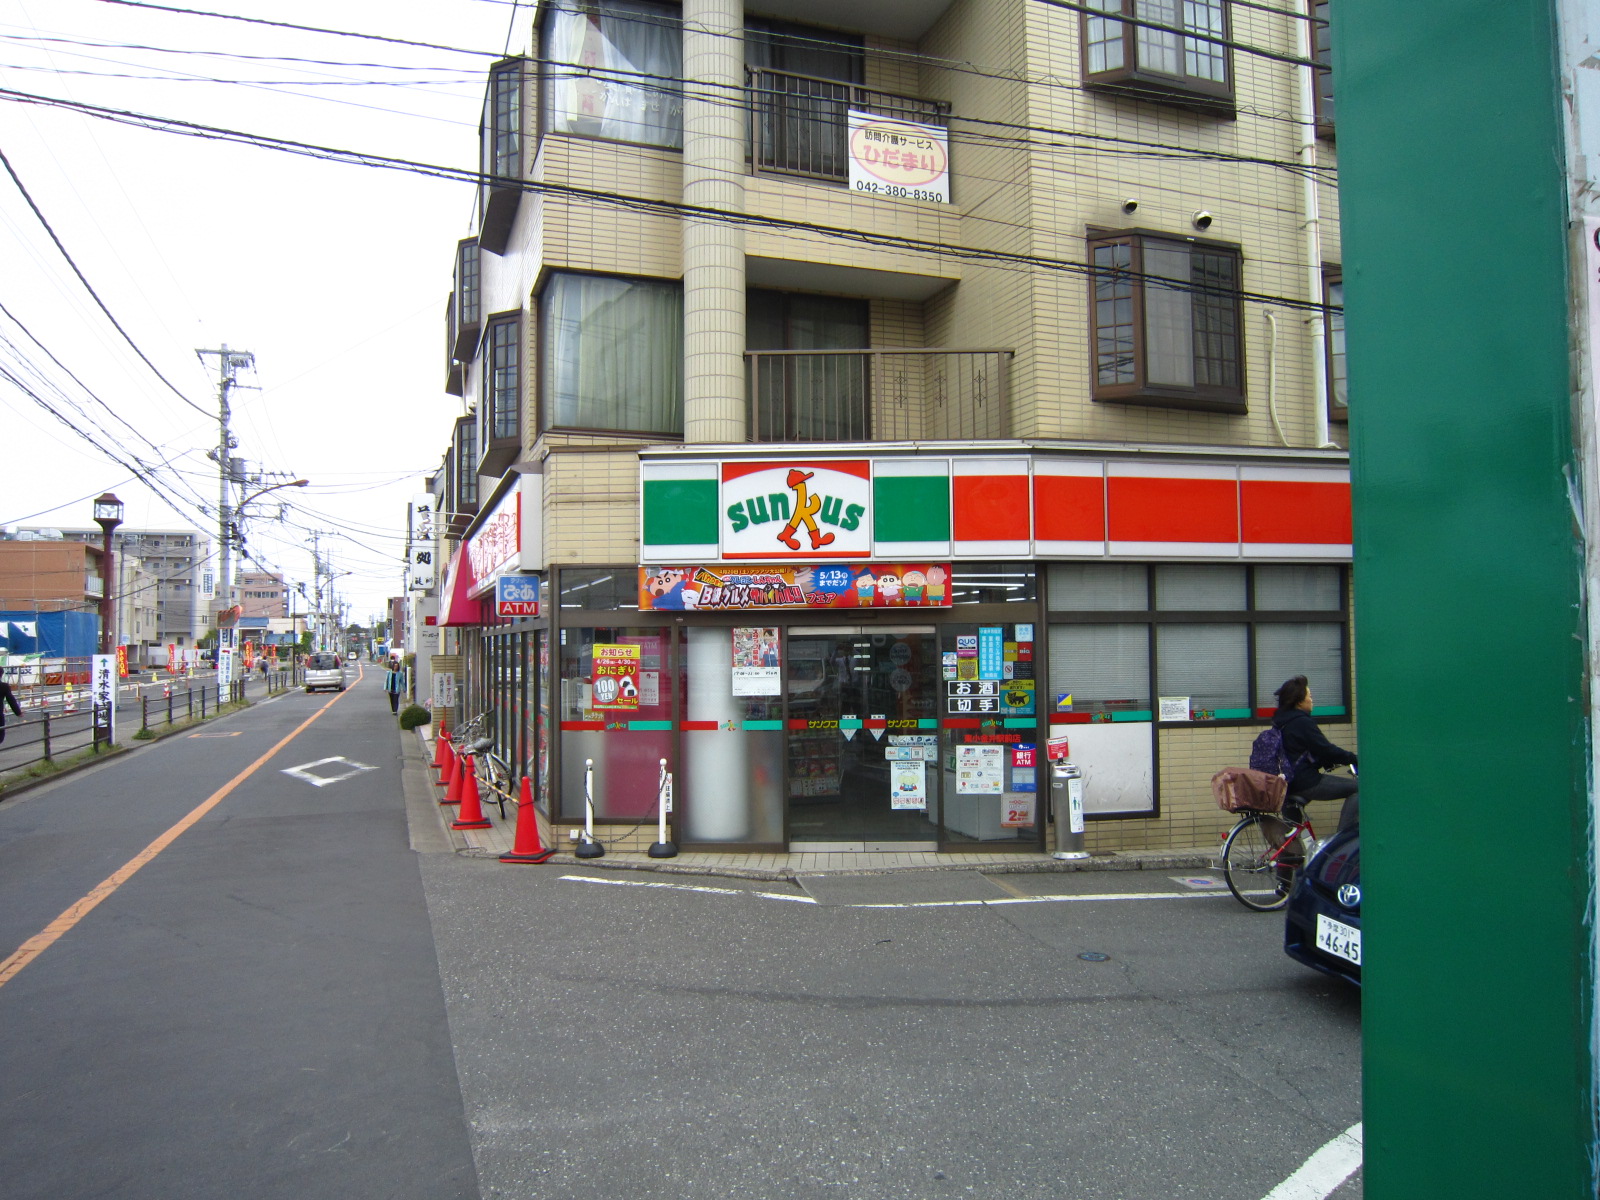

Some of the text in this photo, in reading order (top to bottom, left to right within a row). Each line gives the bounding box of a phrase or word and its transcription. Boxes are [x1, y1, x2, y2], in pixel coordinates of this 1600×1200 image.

[865, 130, 933, 150] 訪問介護サービス
[864, 145, 936, 175] ひだまり
[857, 181, 943, 203] 042-380-8350
[503, 584, 535, 600] ぴあ
[806, 592, 837, 604] フェア
[503, 602, 535, 614] ATM
[958, 638, 976, 646] QUO
[600, 648, 633, 657] お知らせ
[596, 665, 636, 676] おにぎり
[597, 680, 615, 693] 100
[956, 682, 993, 694] お酒
[957, 699, 993, 711] 切手
[808, 720, 838, 728] サンクス
[887, 719, 918, 728] サンクス
[1016, 751, 1031, 759] 銀行
[1325, 933, 1359, 960] 46-45
